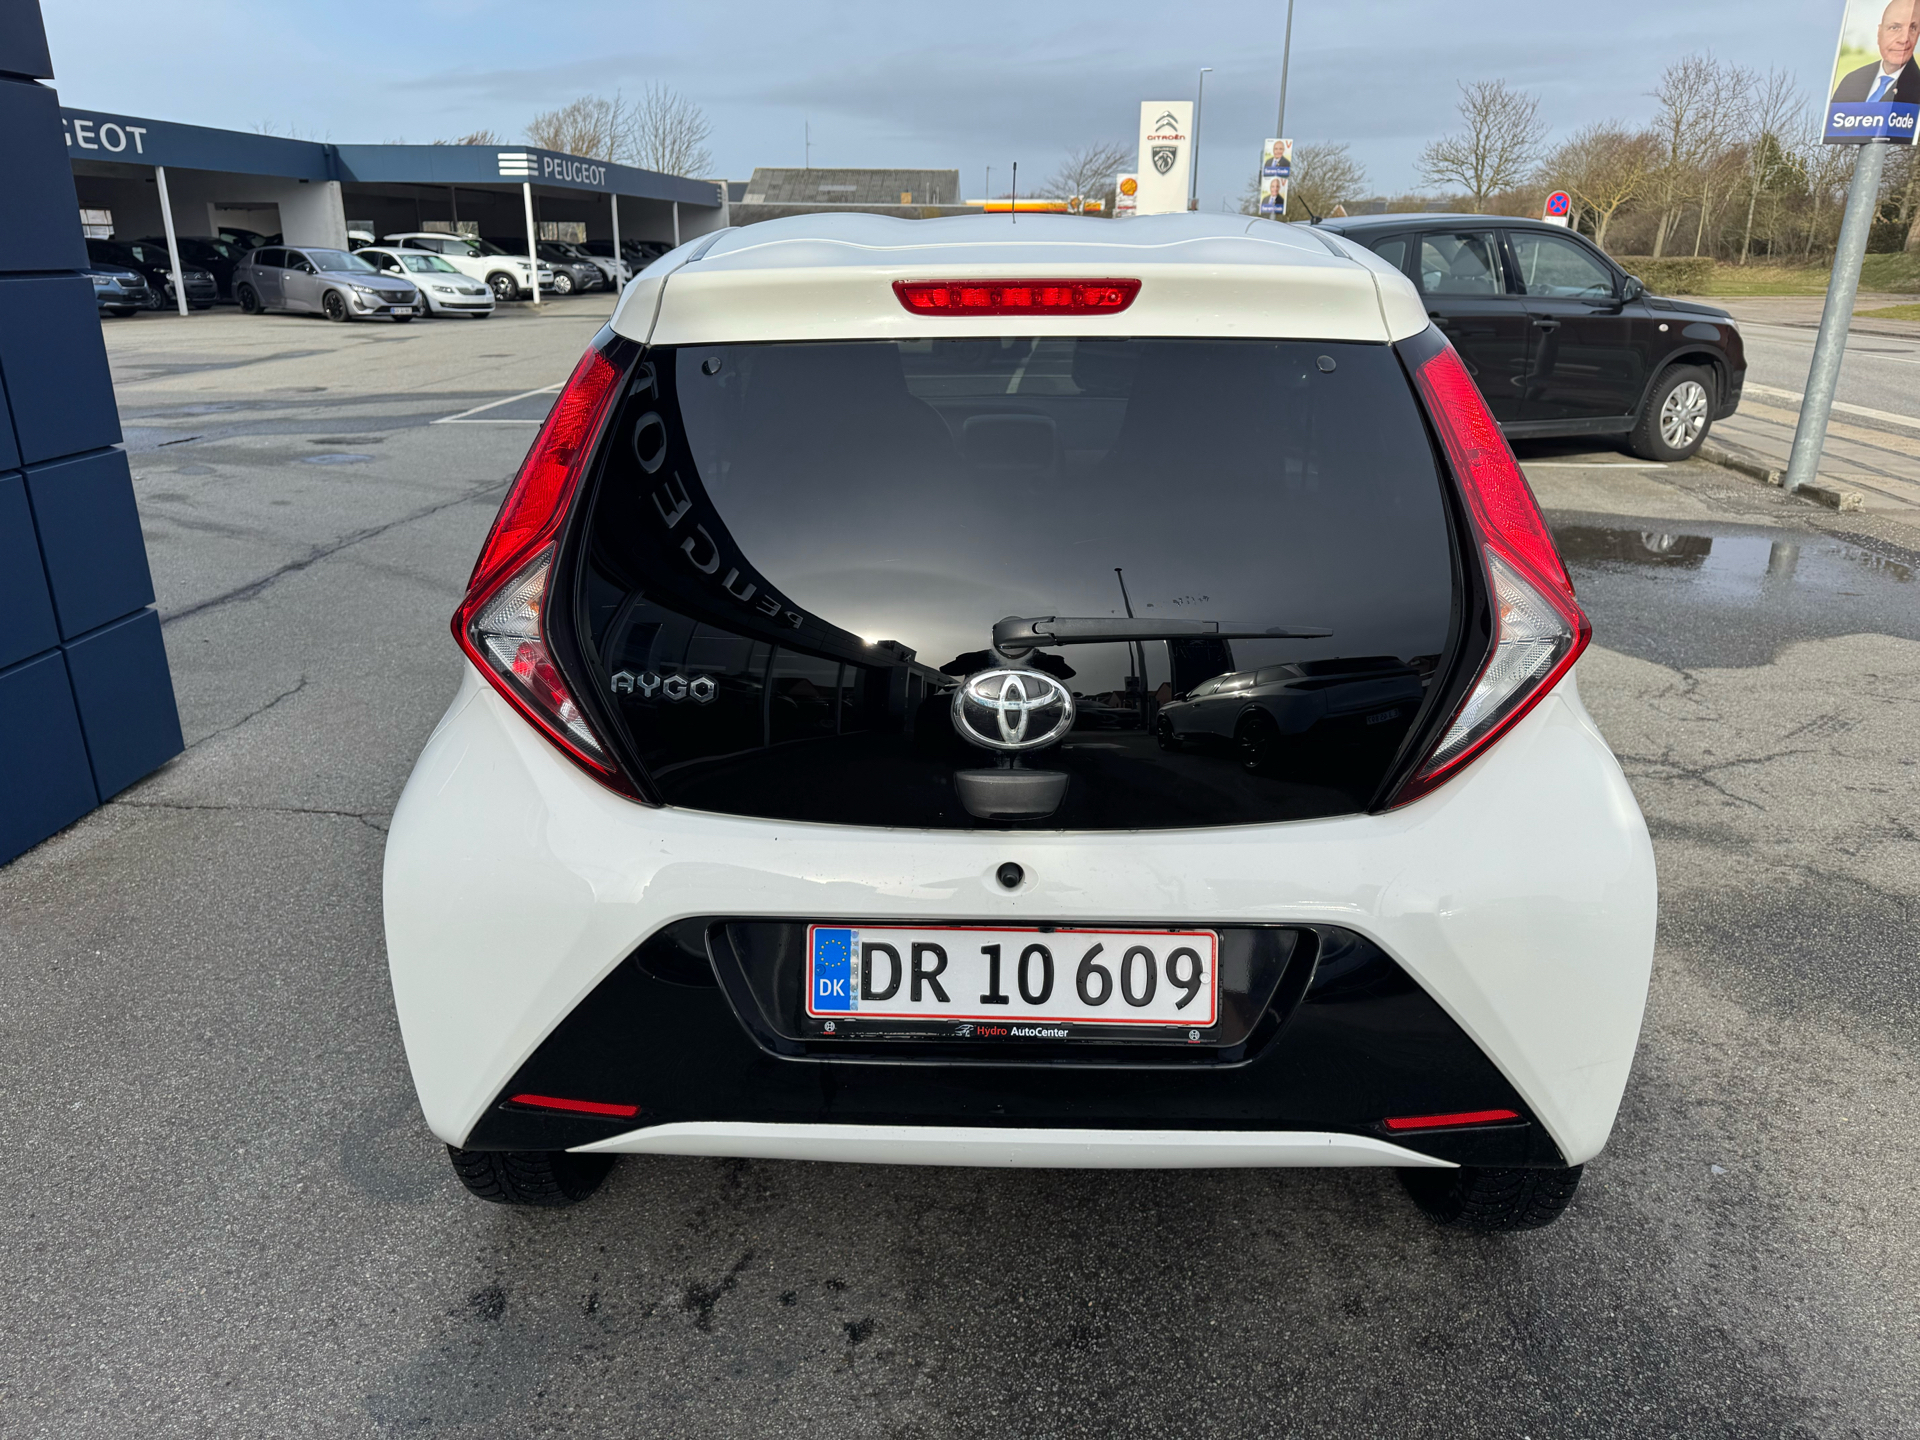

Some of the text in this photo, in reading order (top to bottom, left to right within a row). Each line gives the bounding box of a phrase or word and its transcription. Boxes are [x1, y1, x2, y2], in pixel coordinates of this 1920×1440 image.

[1832, 112, 1914, 129] Søren Gade
[543, 156, 606, 186] PEUGEOT
[610, 671, 716, 703] AYGO
[819, 978, 846, 997] DK
[861, 941, 1204, 1011] DR 10 609
[977, 1026, 1069, 1038] Hydro AutoCenter
